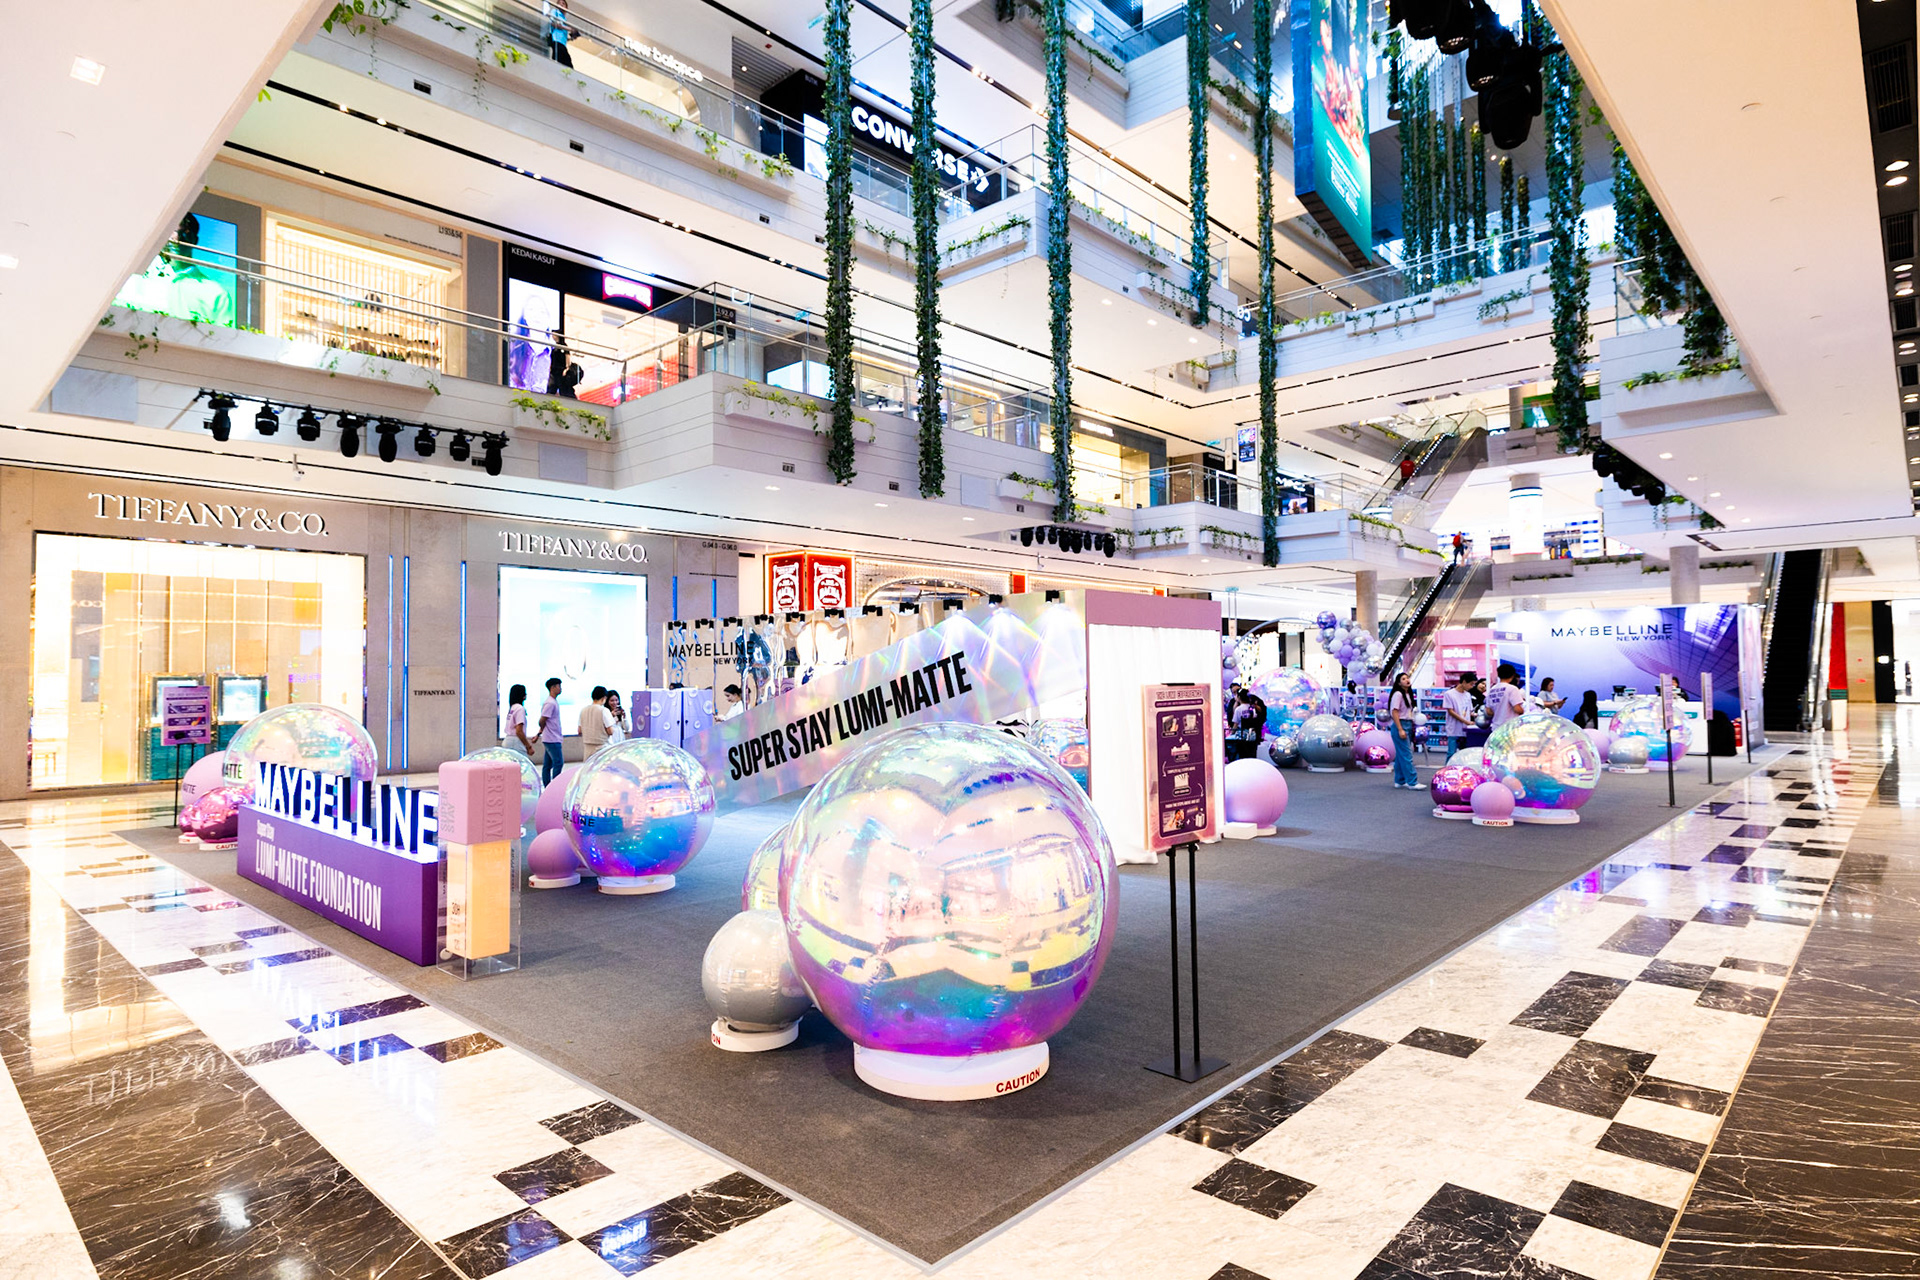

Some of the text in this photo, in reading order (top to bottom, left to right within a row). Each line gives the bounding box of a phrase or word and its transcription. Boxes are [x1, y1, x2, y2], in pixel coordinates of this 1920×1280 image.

[851, 106, 969, 182] CONVRSE
[511, 246, 556, 266] KEDAI KASUT
[1551, 623, 1673, 637] MAYBELLINE
[668, 641, 754, 658] MAYBELLINE
[713, 657, 731, 665] NEW
[728, 650, 972, 781] SUPER STAY LUMI-MATTE
[255, 761, 439, 851] MAYBELLINE
[255, 839, 308, 895] LUMI-MATTE
[309, 860, 382, 931] FOUNDATION
[995, 1067, 1041, 1093] CAUTION
